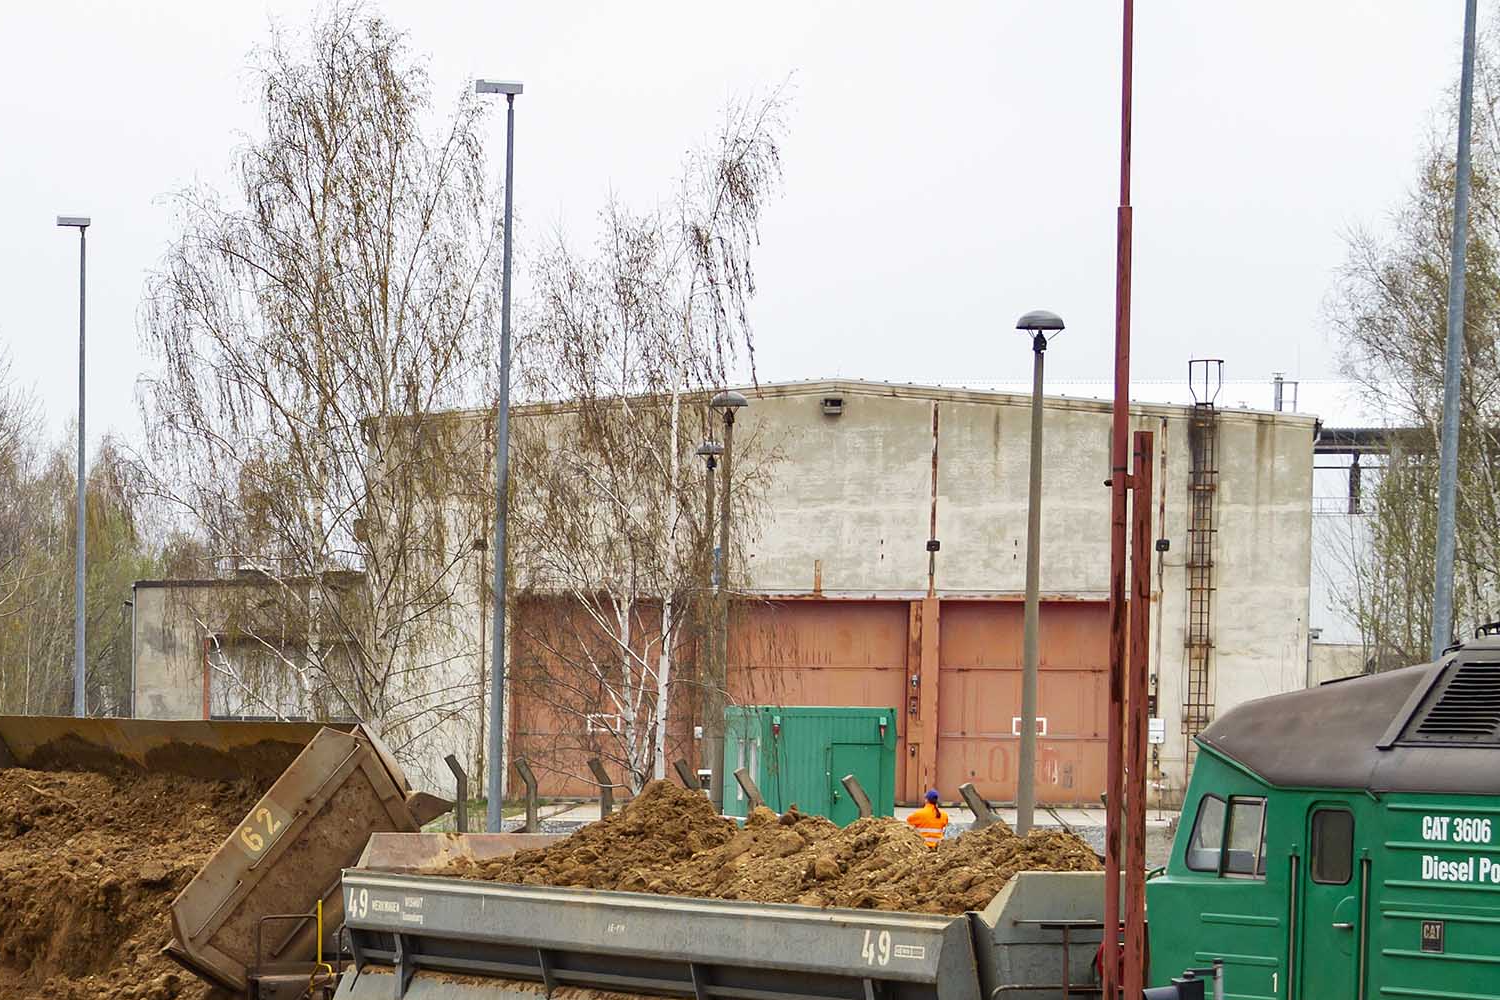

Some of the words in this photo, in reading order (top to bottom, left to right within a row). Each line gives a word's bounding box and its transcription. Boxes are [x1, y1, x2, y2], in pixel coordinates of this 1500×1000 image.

[240, 807, 282, 851] 62
[1422, 816, 1451, 841] CAT
[1453, 818, 1492, 843] 3606
[1422, 855, 1474, 882] Diesel
[348, 887, 369, 919] 49
[1423, 924, 1441, 939] CAT
[861, 929, 892, 966] 49
[1272, 972, 1278, 993] 1
